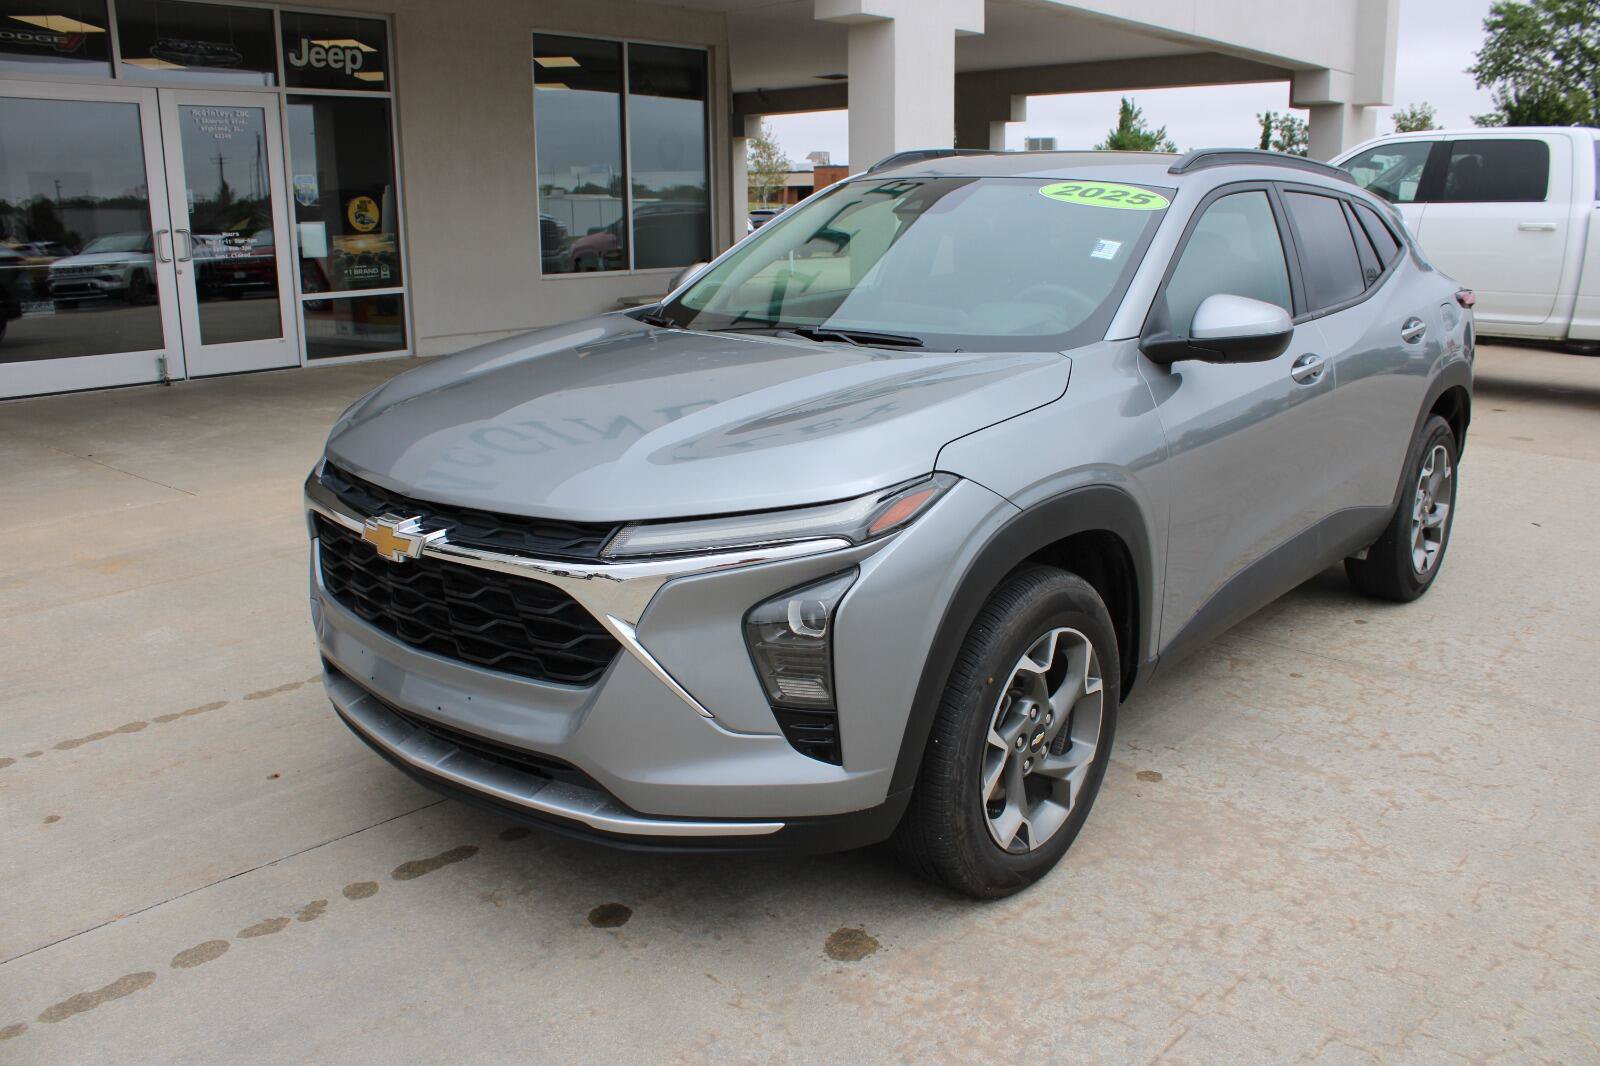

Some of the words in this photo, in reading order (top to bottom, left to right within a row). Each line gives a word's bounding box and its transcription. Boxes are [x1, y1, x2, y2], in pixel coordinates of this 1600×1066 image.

[289, 38, 363, 75] Jeep
[1051, 185, 1157, 206] 2025
[354, 267, 379, 275] BRAND
